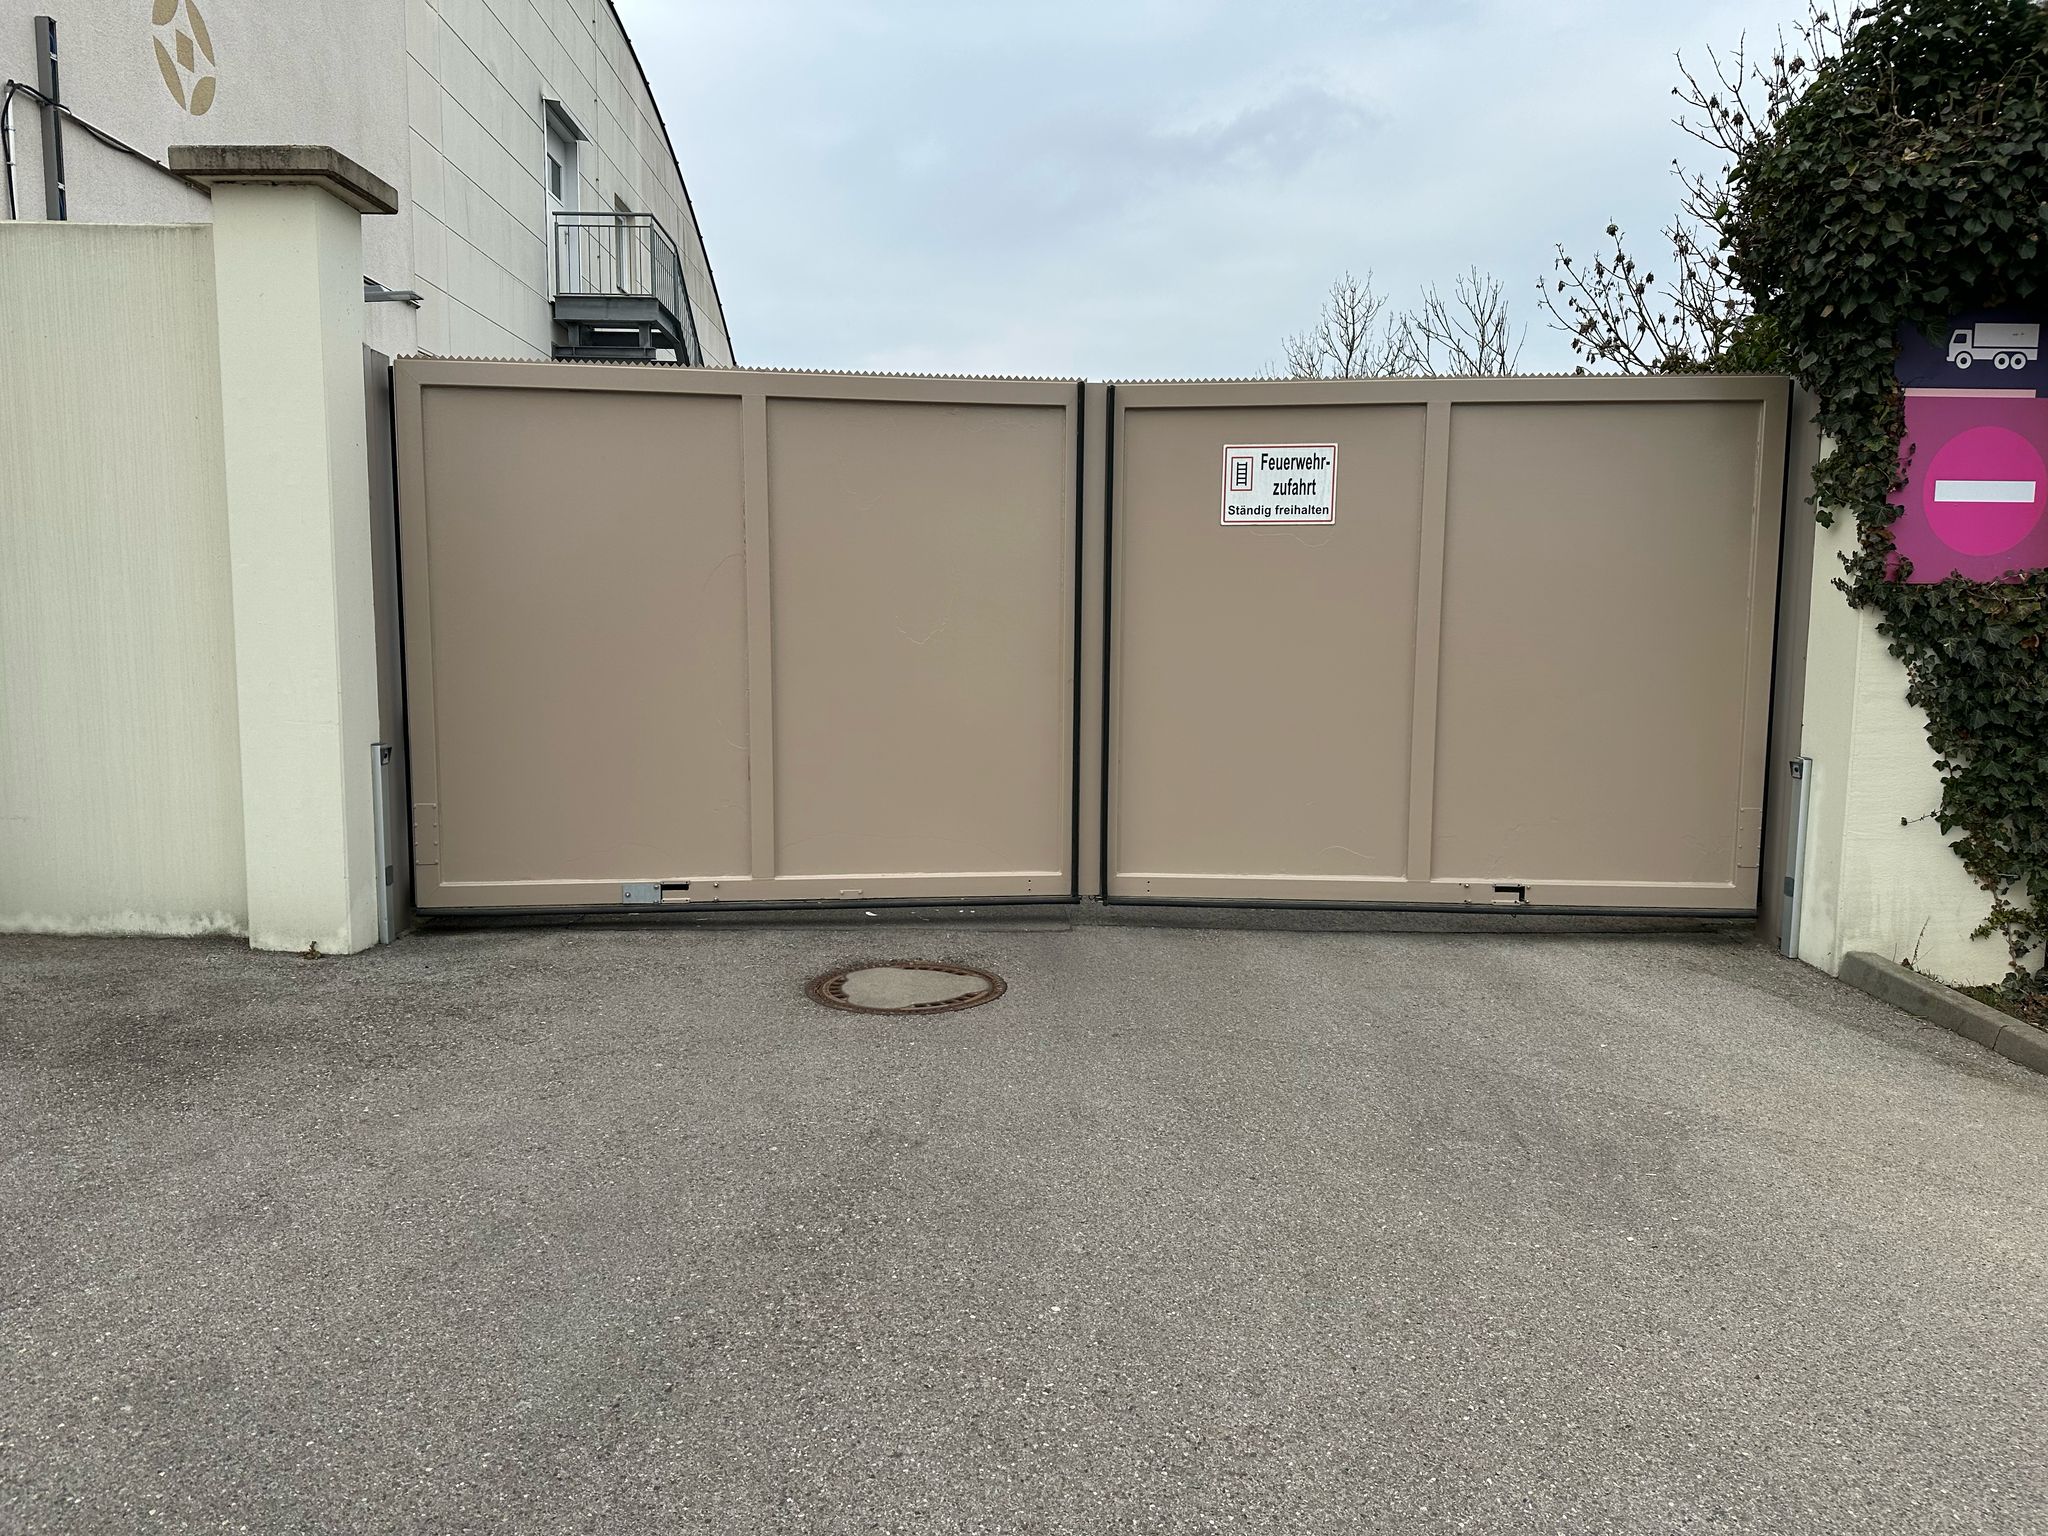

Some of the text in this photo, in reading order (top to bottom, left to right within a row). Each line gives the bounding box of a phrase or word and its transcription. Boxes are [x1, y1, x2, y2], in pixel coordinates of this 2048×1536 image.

[1260, 453, 1330, 470] Feuerwehr-
[1272, 478, 1316, 496] zufahrt
[1228, 505, 1329, 517] Ständig freihalten
